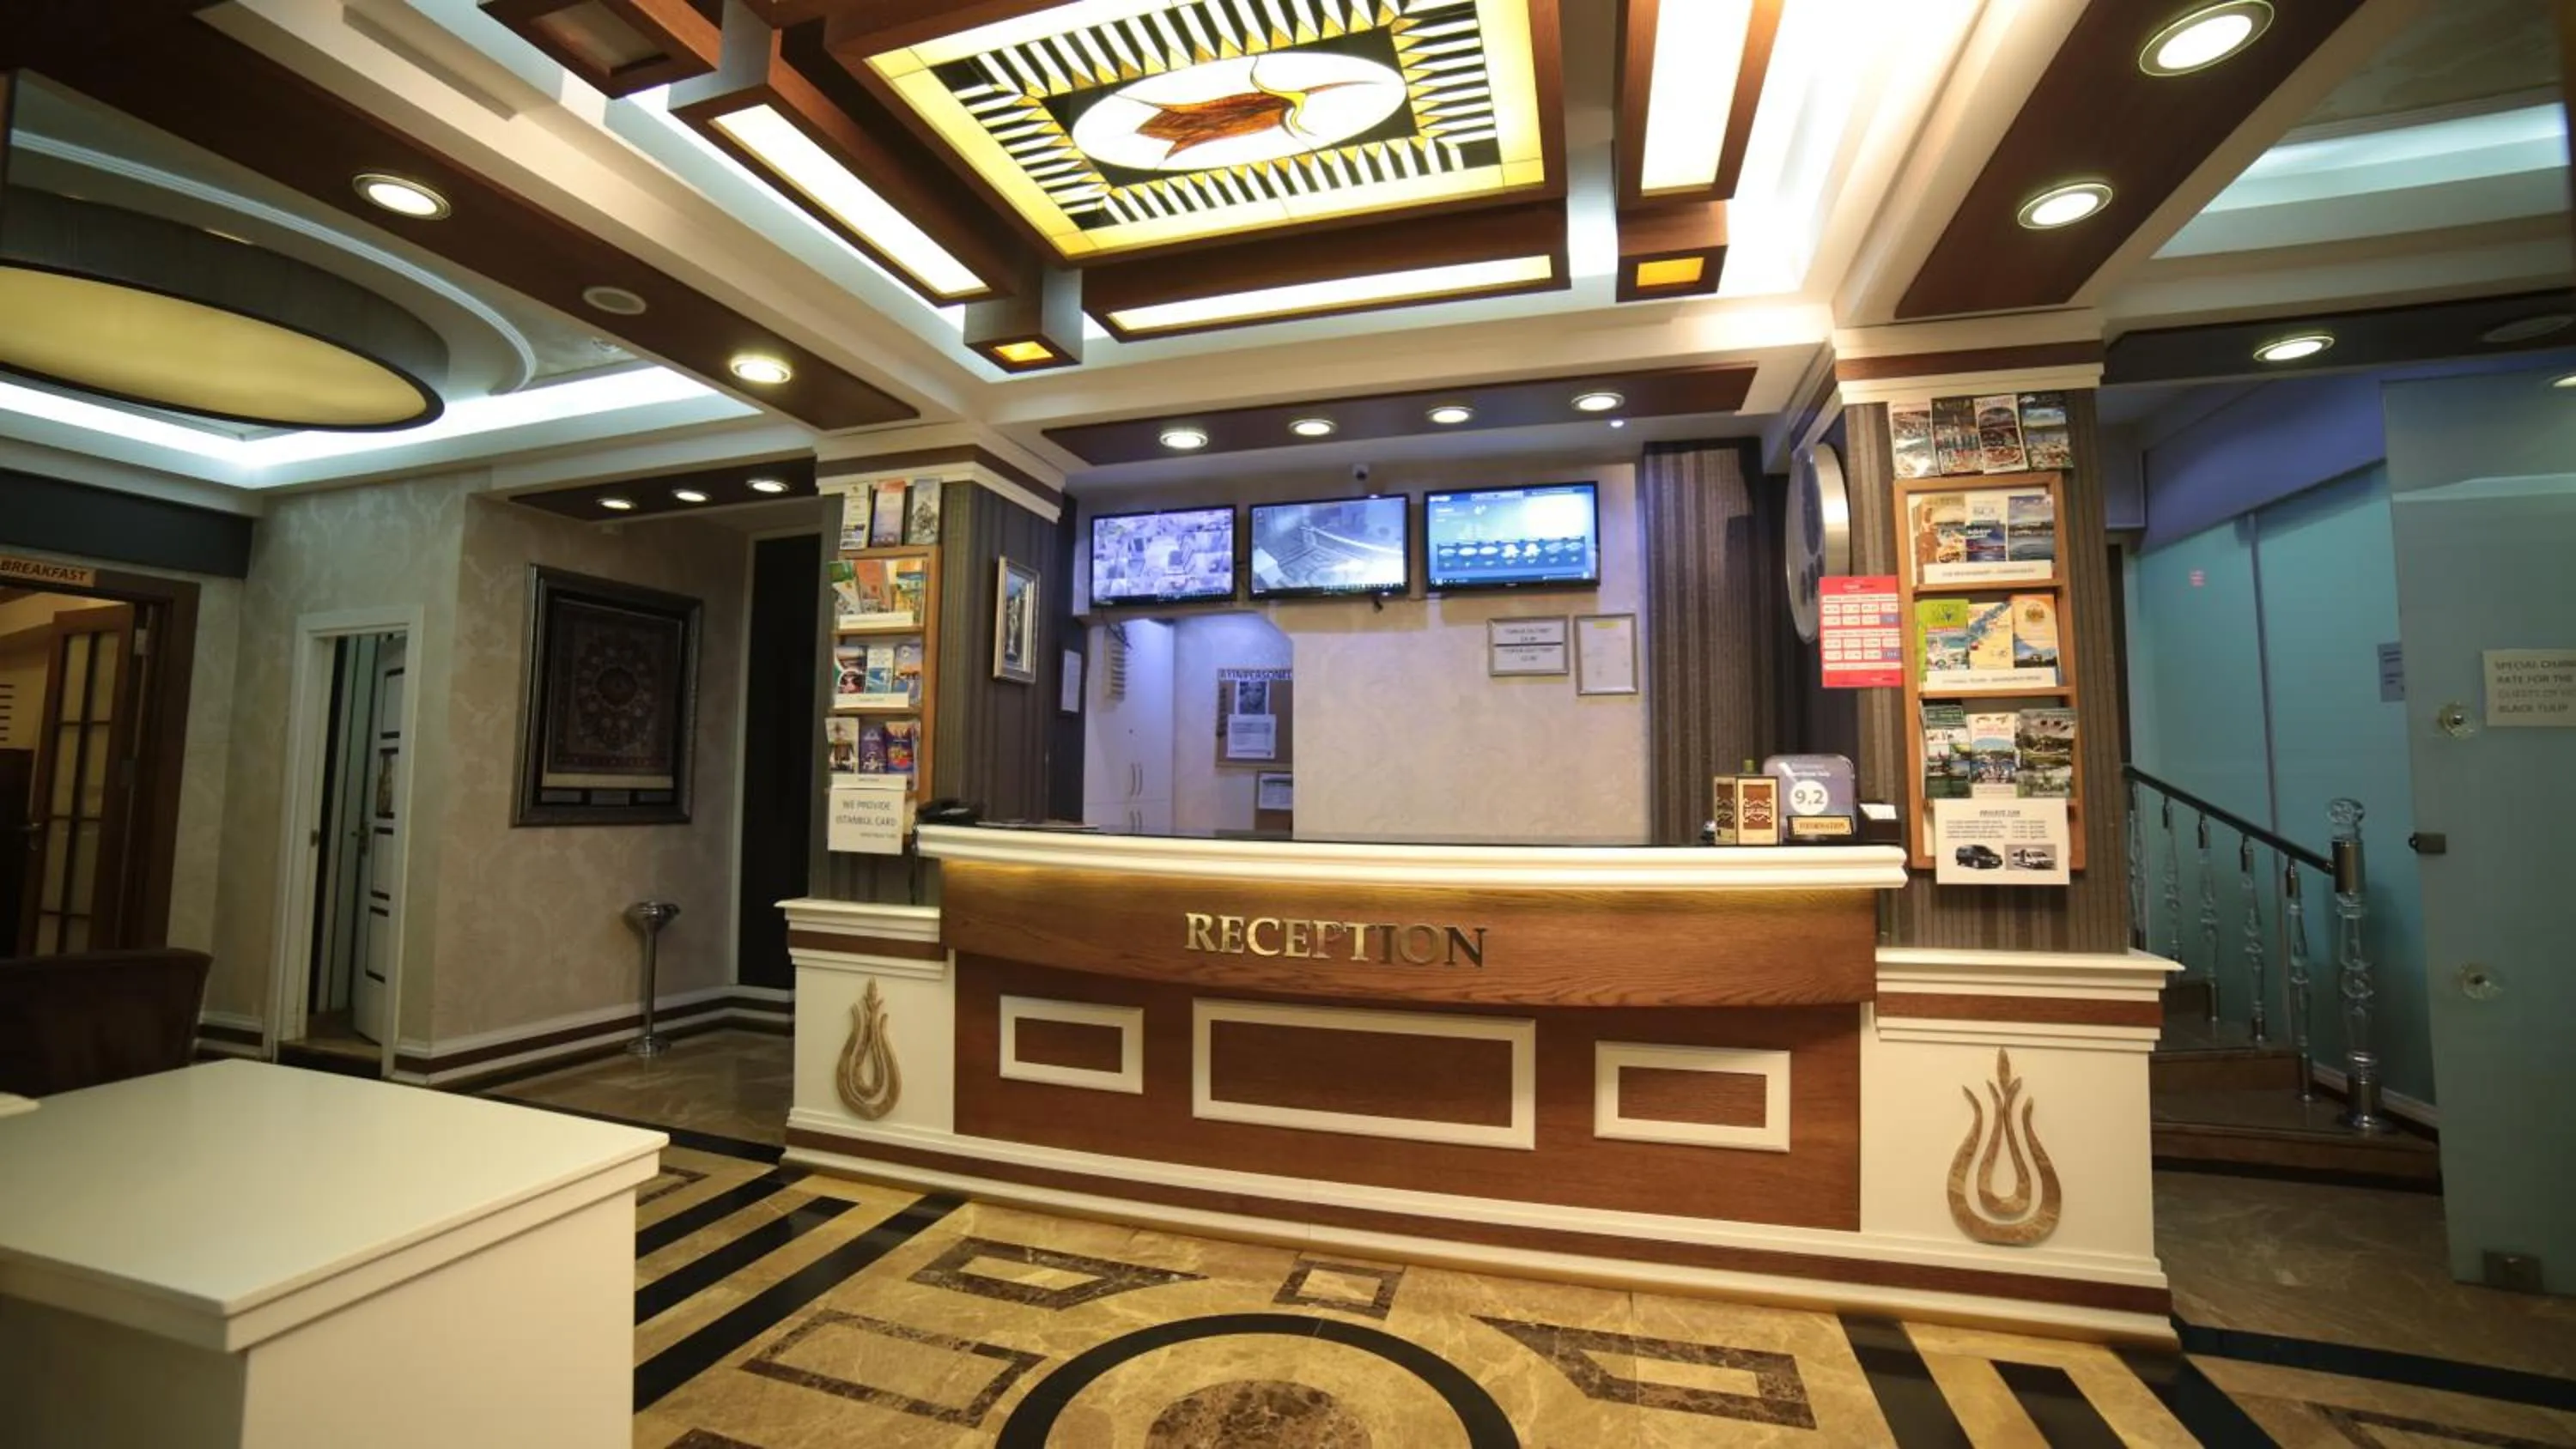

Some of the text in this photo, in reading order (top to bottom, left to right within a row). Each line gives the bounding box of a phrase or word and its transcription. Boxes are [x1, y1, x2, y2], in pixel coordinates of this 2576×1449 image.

[1, 560, 88, 581] BREAKFAST
[2527, 675, 2549, 683] FOR
[2553, 674, 2573, 683] THE
[2499, 703, 2569, 713] BLACK TULIP
[1184, 912, 1489, 968] RECEPTION
